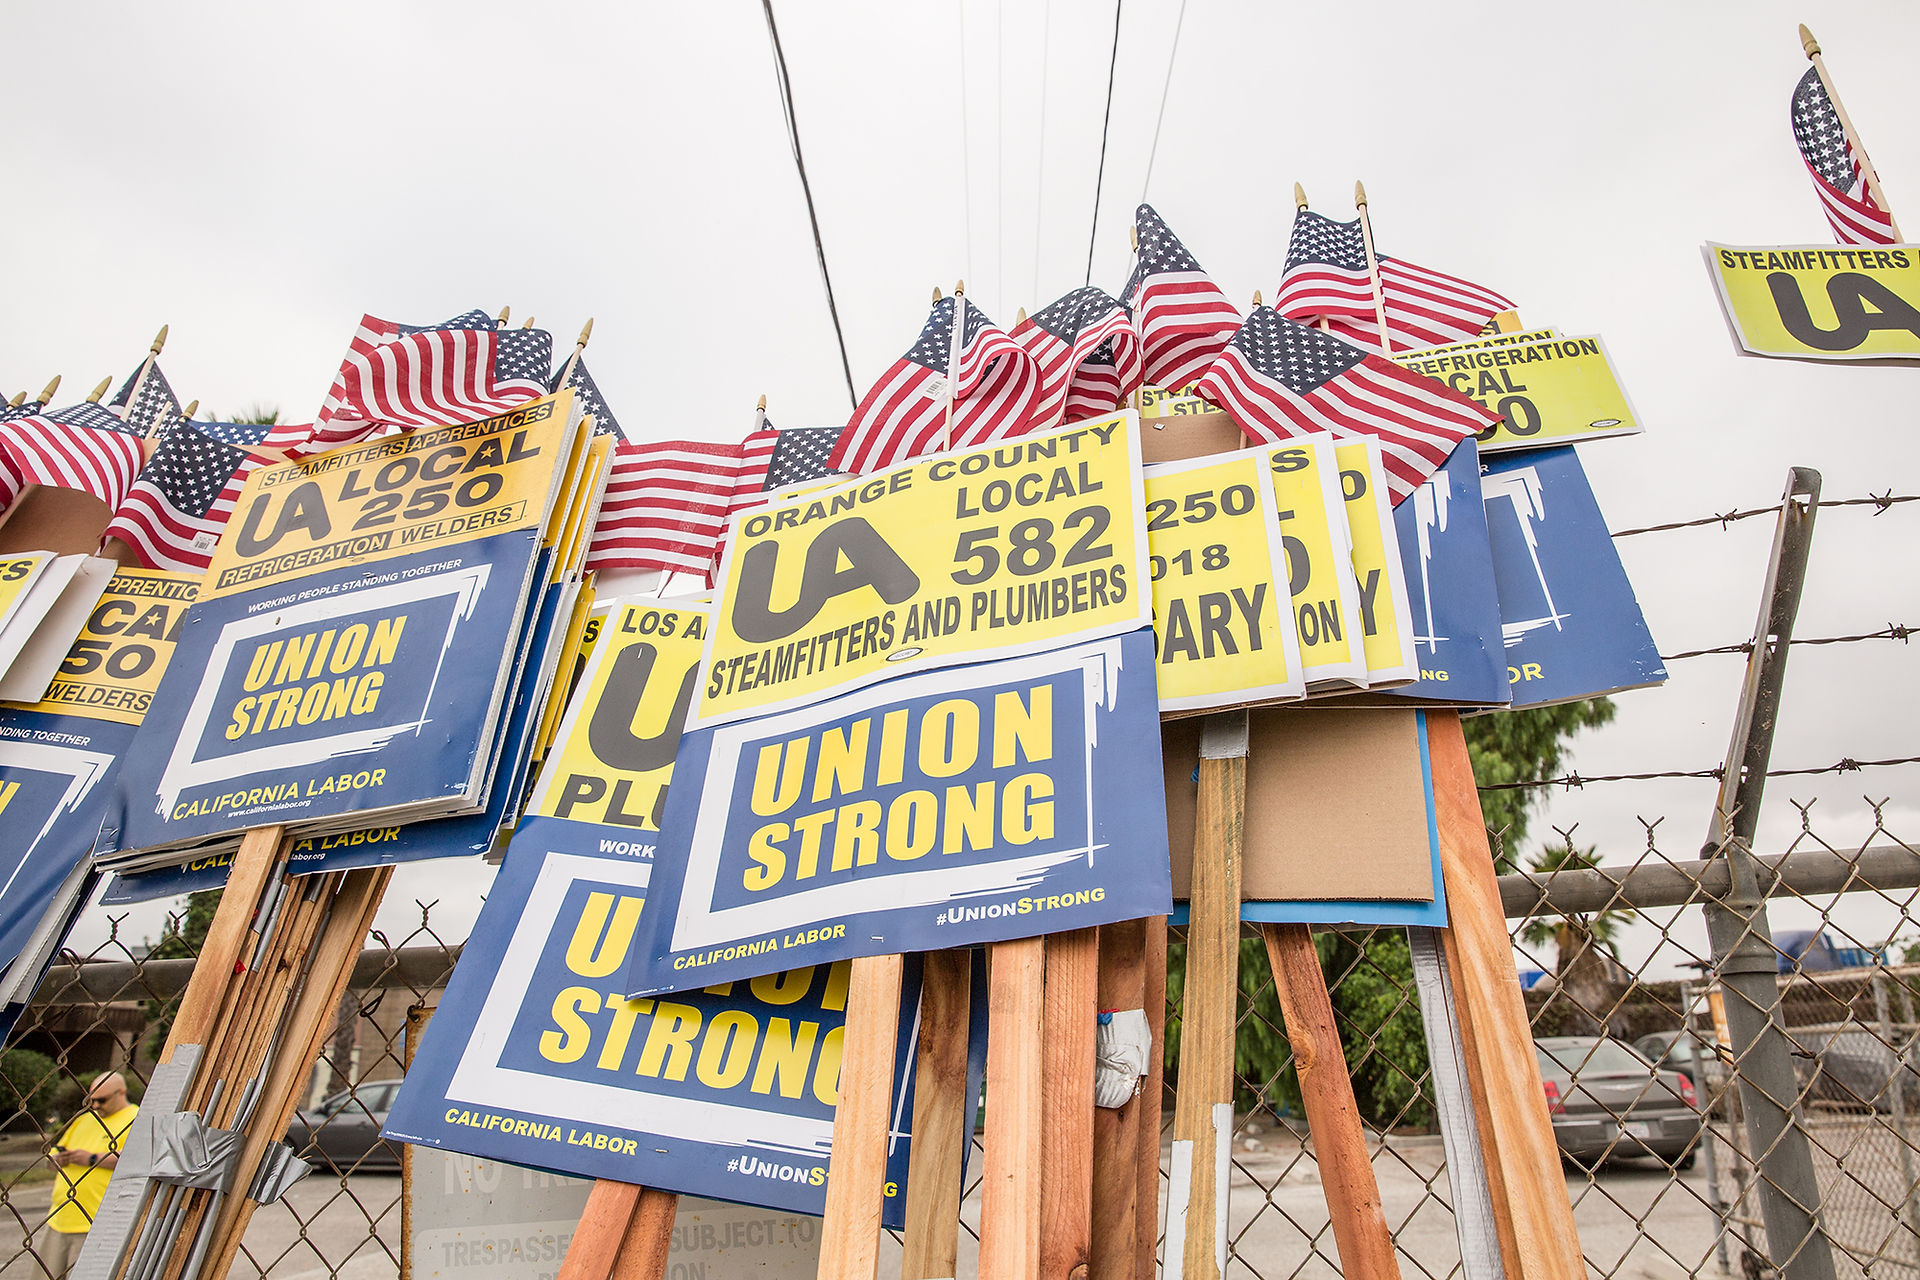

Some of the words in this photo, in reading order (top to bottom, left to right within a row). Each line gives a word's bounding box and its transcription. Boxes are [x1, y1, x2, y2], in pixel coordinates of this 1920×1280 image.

[1720, 249, 1910, 270] STEAMFITTERS
[1766, 271, 1920, 351] UA
[264, 441, 405, 488] STEAMFITTERS
[410, 403, 550, 452] APPRENTICES
[744, 468, 913, 538] ORANGE
[929, 422, 1120, 483] COUNTY
[235, 481, 332, 558] UA
[338, 430, 542, 502] LOCAL
[351, 473, 504, 532] 250
[1146, 484, 1256, 532] 250
[223, 533, 389, 584] REFRIGERATION
[401, 506, 513, 545] WELDERS
[731, 517, 920, 644] UA
[956, 461, 1104, 519] LOCAL
[950, 505, 1114, 586] 582
[248, 594, 296, 613] WORKING
[297, 584, 340, 601] PEOPLE
[341, 572, 399, 591] STANDING
[401, 558, 463, 579] TOGETHER
[621, 608, 678, 636] LOS
[244, 615, 408, 692] UNION
[707, 610, 895, 699] STEAMFITTERS
[901, 598, 961, 645] AND
[970, 564, 1127, 632] PLUMBERS
[1153, 582, 1267, 666] ARY
[43, 682, 153, 711] WELDERS
[225, 671, 385, 740] STRONG
[32, 730, 91, 747] TOGETHER
[750, 684, 1054, 817] UNION
[172, 782, 299, 821] CALIFORNIA
[306, 768, 387, 797] LABOR
[742, 772, 1055, 892] STRONG
[672, 938, 779, 971] CALIFORNIA
[783, 923, 847, 948] LABOR
[445, 1108, 562, 1142] CALIFORNIA
[567, 1128, 638, 1156] LABOR
[669, 1219, 776, 1253] SUBJECT
[783, 1216, 815, 1244] TO
